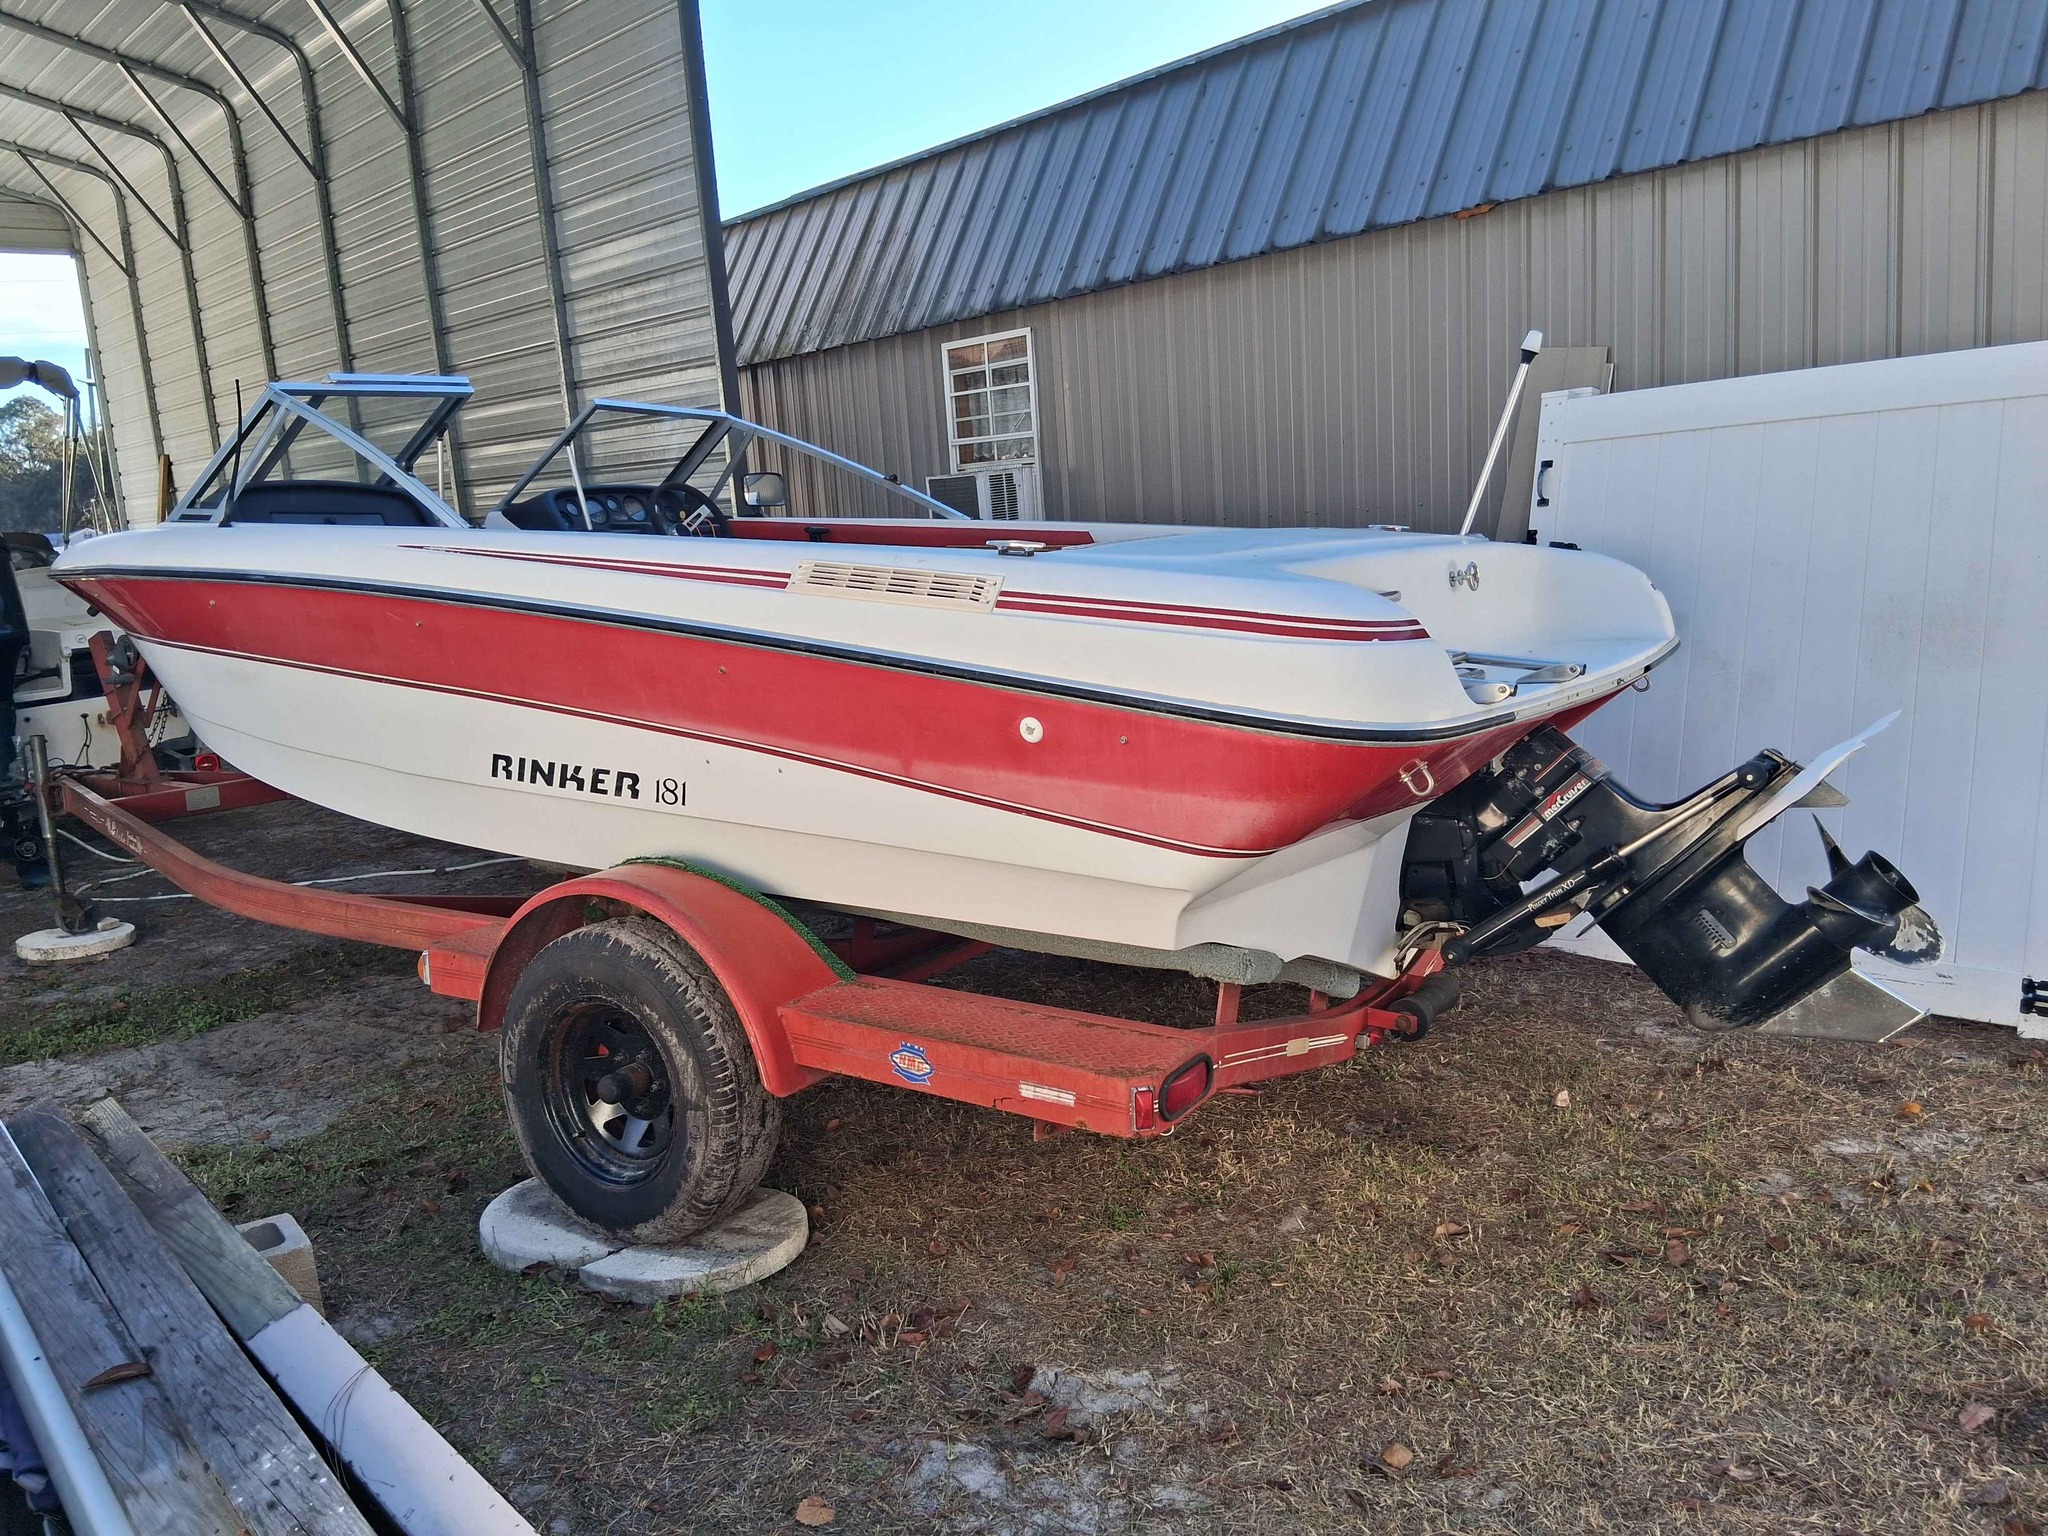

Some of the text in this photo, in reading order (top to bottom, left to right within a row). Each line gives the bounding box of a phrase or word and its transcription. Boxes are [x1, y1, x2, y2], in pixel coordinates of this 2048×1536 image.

[491, 753, 687, 806] RINKER 181
[1527, 879, 1576, 912] Power Trim XD
